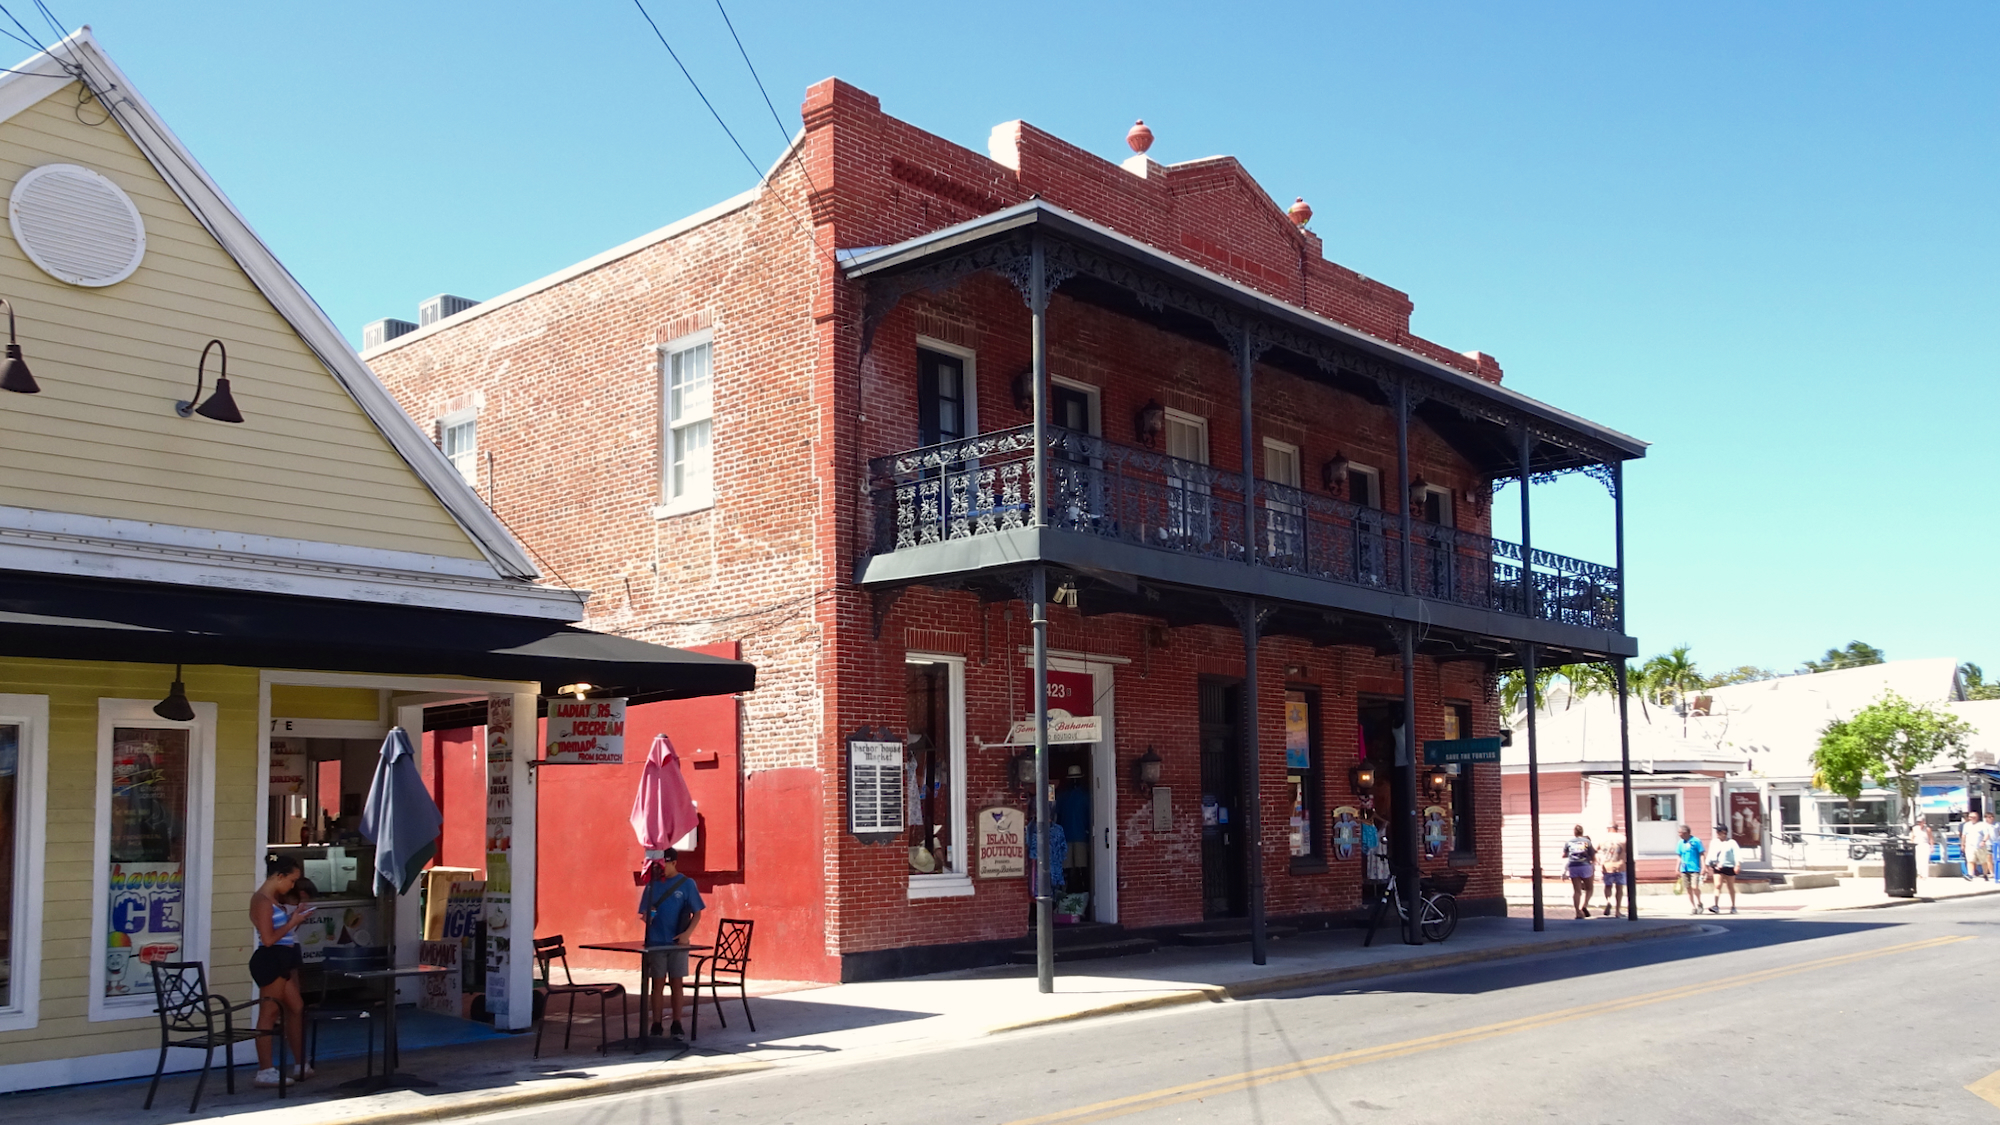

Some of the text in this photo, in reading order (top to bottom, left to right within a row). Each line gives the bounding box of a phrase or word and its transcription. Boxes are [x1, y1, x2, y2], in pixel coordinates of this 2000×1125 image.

[286, 721, 293, 730] E
[1055, 721, 1095, 731] Bahama
[595, 753, 623, 761] SCRATCH
[986, 833, 1018, 845] ISLAND
[981, 845, 1023, 860] BOUTIQUE
